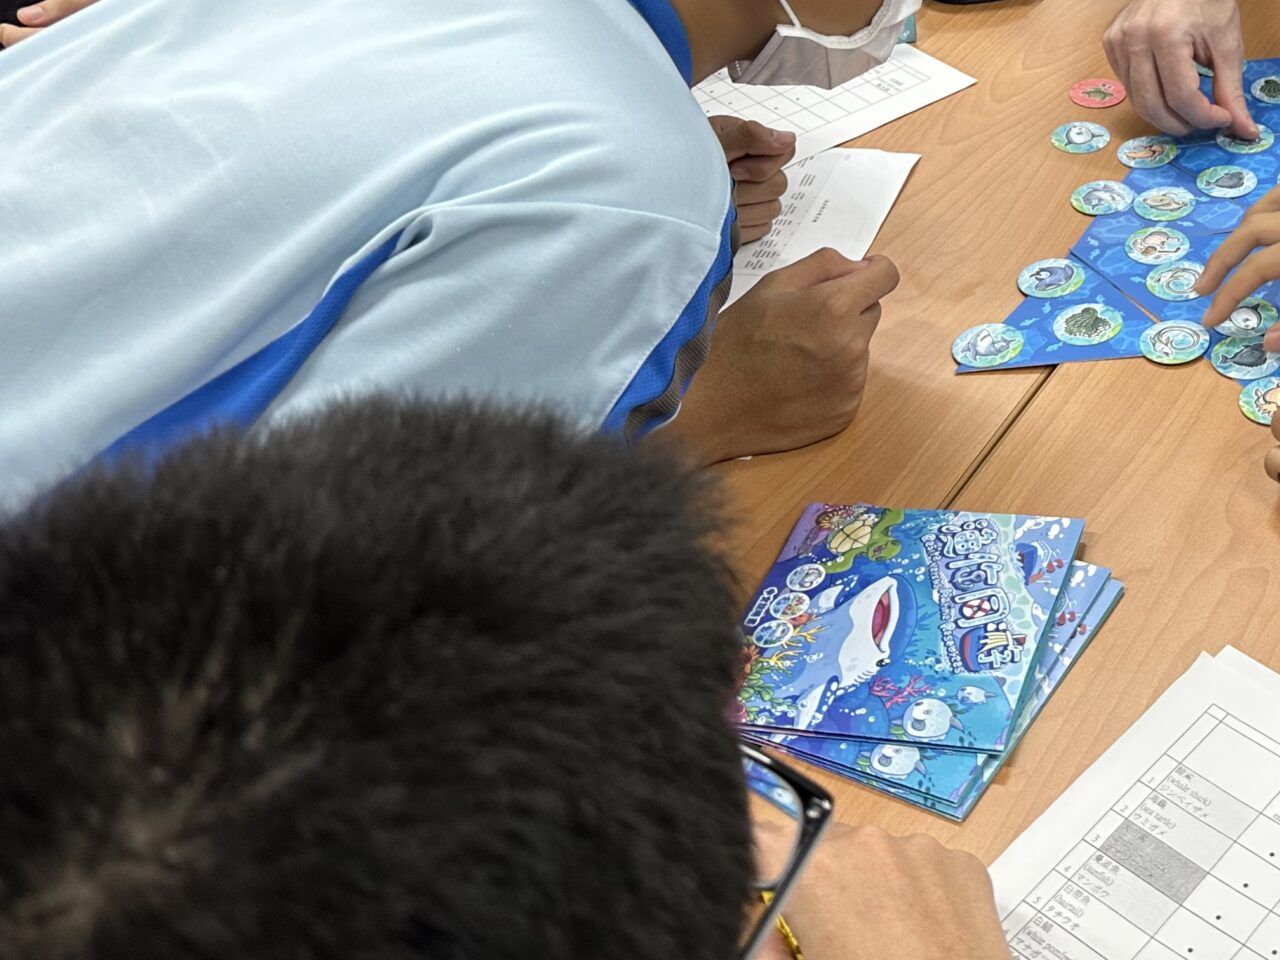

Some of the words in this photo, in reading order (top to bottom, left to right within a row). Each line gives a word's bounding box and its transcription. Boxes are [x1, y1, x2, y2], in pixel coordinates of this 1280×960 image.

[939, 587, 954, 622] Marine
[939, 621, 963, 674] Resources
[1120, 804, 1128, 813] 2
[1091, 834, 1100, 843] 3
[1032, 896, 1041, 904] 5
